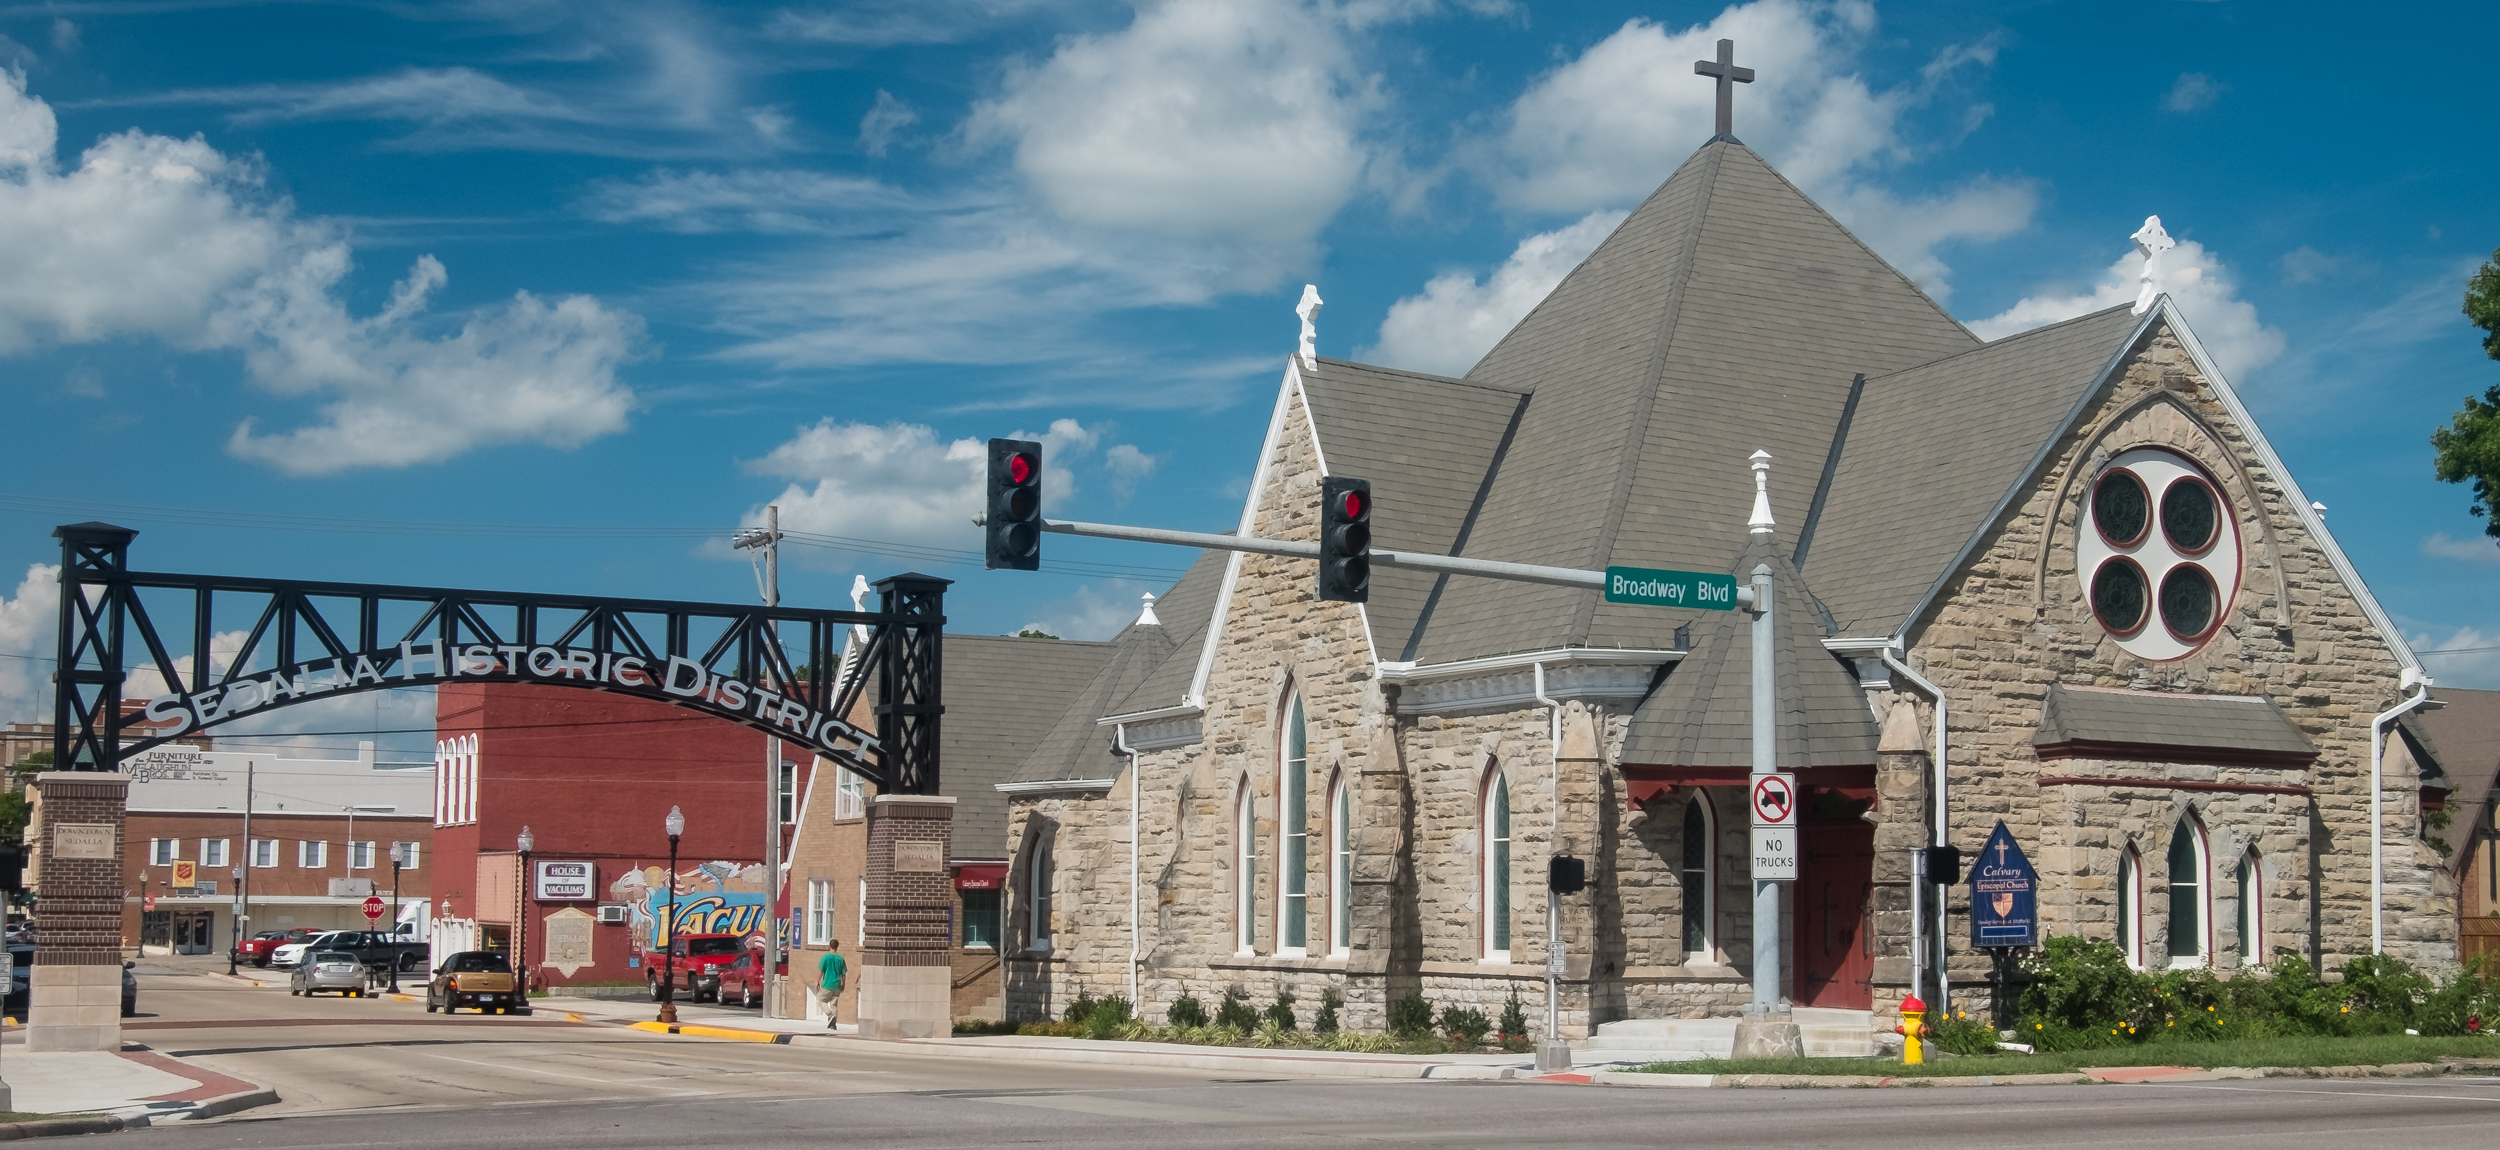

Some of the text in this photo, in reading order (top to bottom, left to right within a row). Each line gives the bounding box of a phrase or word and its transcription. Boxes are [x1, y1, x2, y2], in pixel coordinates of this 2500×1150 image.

[1613, 575, 1729, 604] Broadway Blvd
[145, 638, 881, 762] SEDALIA HISTORIC DISTRICT
[149, 752, 203, 760] FURNITURE
[1766, 839, 1782, 851] NO
[1755, 857, 1793, 868] TRUCKS
[551, 867, 580, 876] HOUSE
[1983, 865, 2021, 878] Calvary
[546, 885, 584, 894] VACUUMS
[1976, 880, 2029, 891] Episcopal Church
[363, 903, 384, 913] STOP
